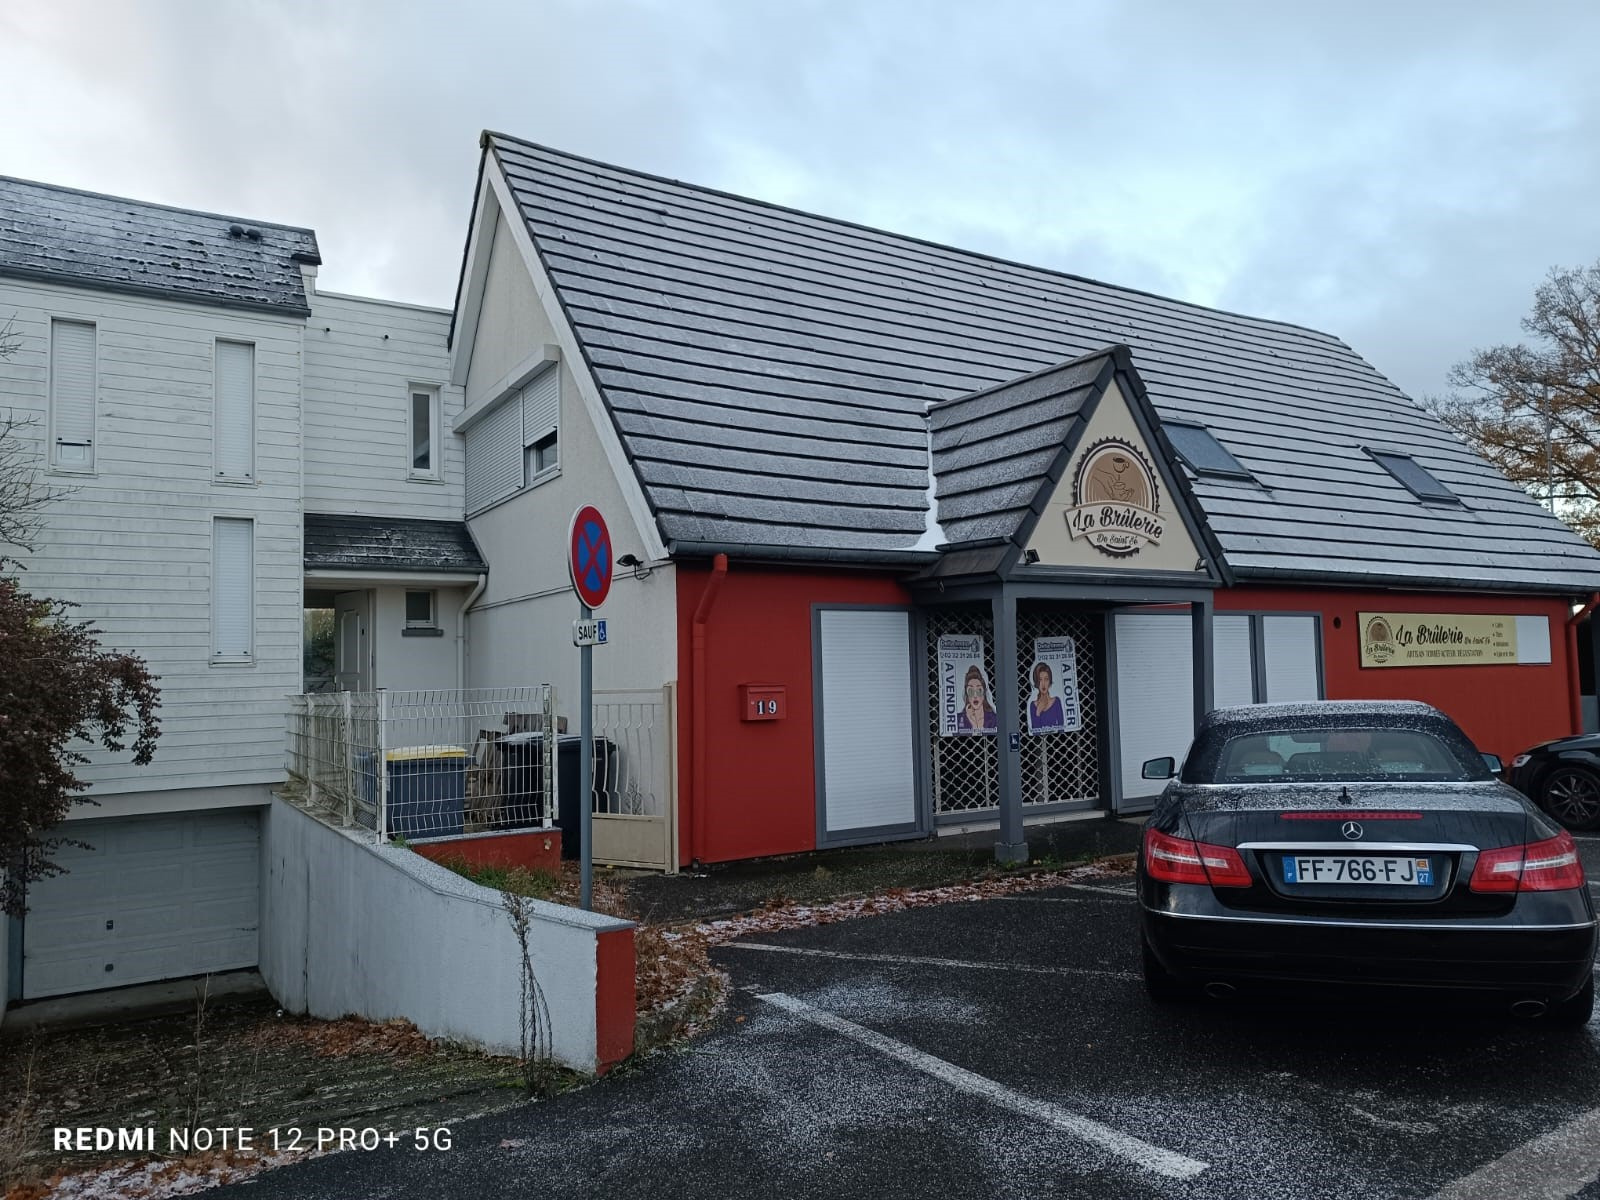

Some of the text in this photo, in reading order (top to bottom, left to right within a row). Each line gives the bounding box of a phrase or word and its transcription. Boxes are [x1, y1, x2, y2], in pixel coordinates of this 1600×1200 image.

[1072, 505, 1163, 539] La Brûlerie
[578, 624, 597, 640] SAUF
[1395, 624, 1413, 647] La
[1416, 624, 1464, 645] Brûlerie
[945, 662, 956, 732] A VENDRE
[1062, 663, 1076, 726] A LOUER
[757, 700, 777, 715] 19
[1297, 859, 1414, 882] FF-766-FJ
[1419, 872, 1429, 883] 27
